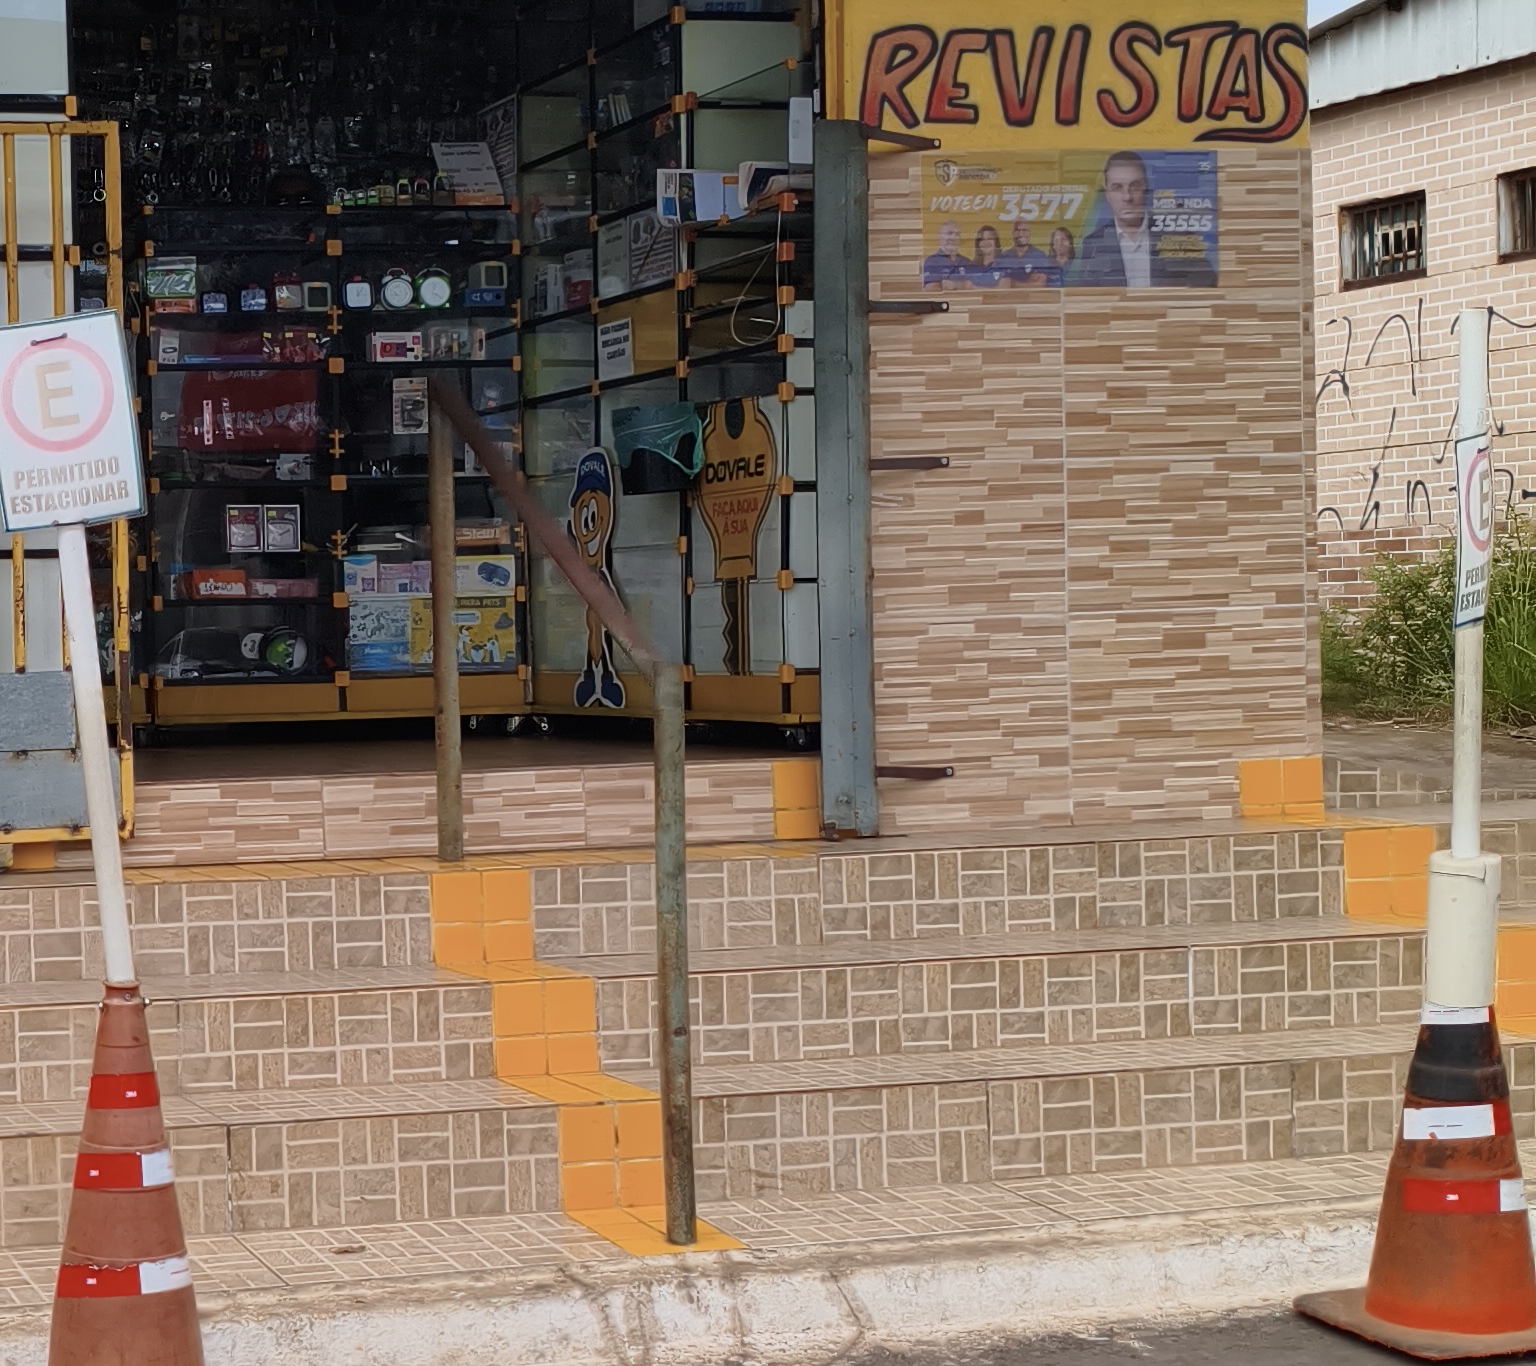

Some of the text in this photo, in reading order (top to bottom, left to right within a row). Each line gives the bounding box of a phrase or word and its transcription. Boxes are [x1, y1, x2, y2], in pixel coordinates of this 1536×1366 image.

[860, 20, 1310, 143] REVISTAS
[998, 192, 1084, 222] 3577
[35, 360, 81, 430] E
[15, 456, 121, 491] PERMITIDO
[705, 453, 766, 484] DOVALE
[10, 480, 130, 516] ESTACIONAR
